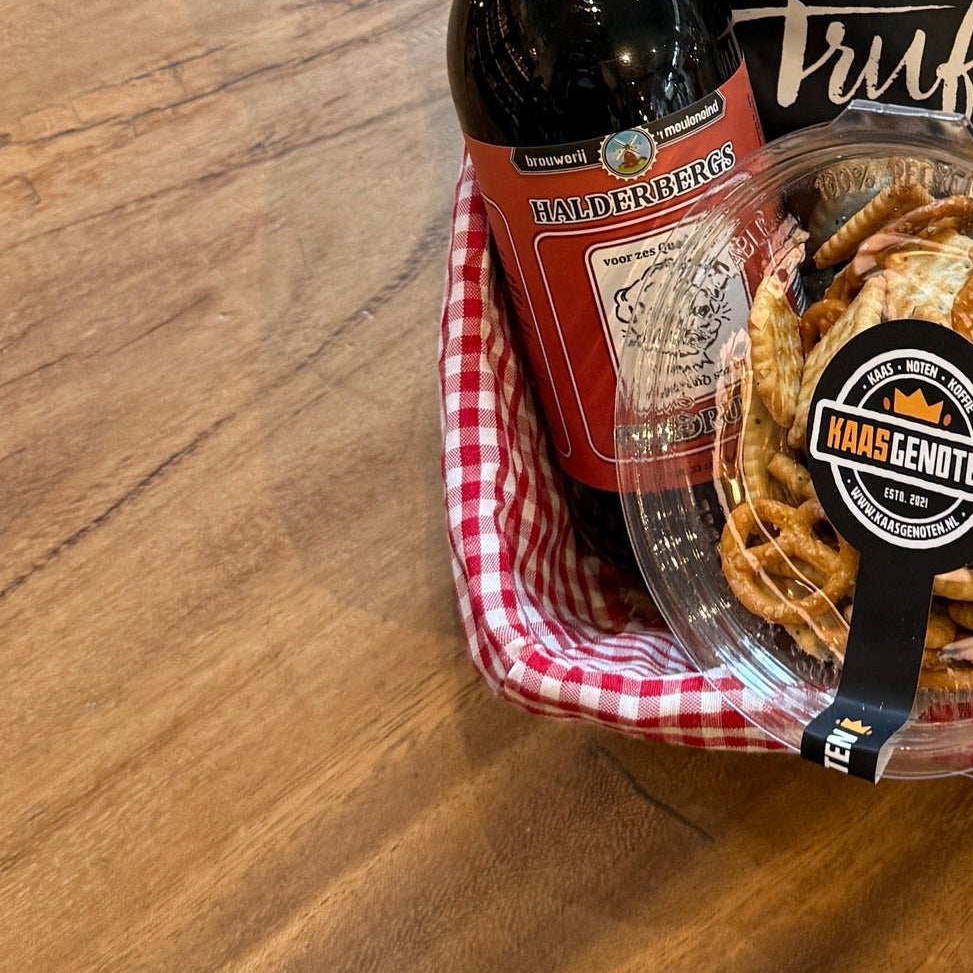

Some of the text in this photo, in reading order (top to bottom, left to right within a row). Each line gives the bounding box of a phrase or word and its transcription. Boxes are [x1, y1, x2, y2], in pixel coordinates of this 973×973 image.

[525, 149, 588, 168] brouwerij
[529, 141, 736, 224] HALDERBERGS
[603, 248, 657, 267] voor zes
[866, 362, 894, 386] KAAS
[906, 359, 939, 379] NOTEN
[850, 486, 960, 539] WWW.KAASGENOTEN.NL
[909, 493, 929, 509] 2021
